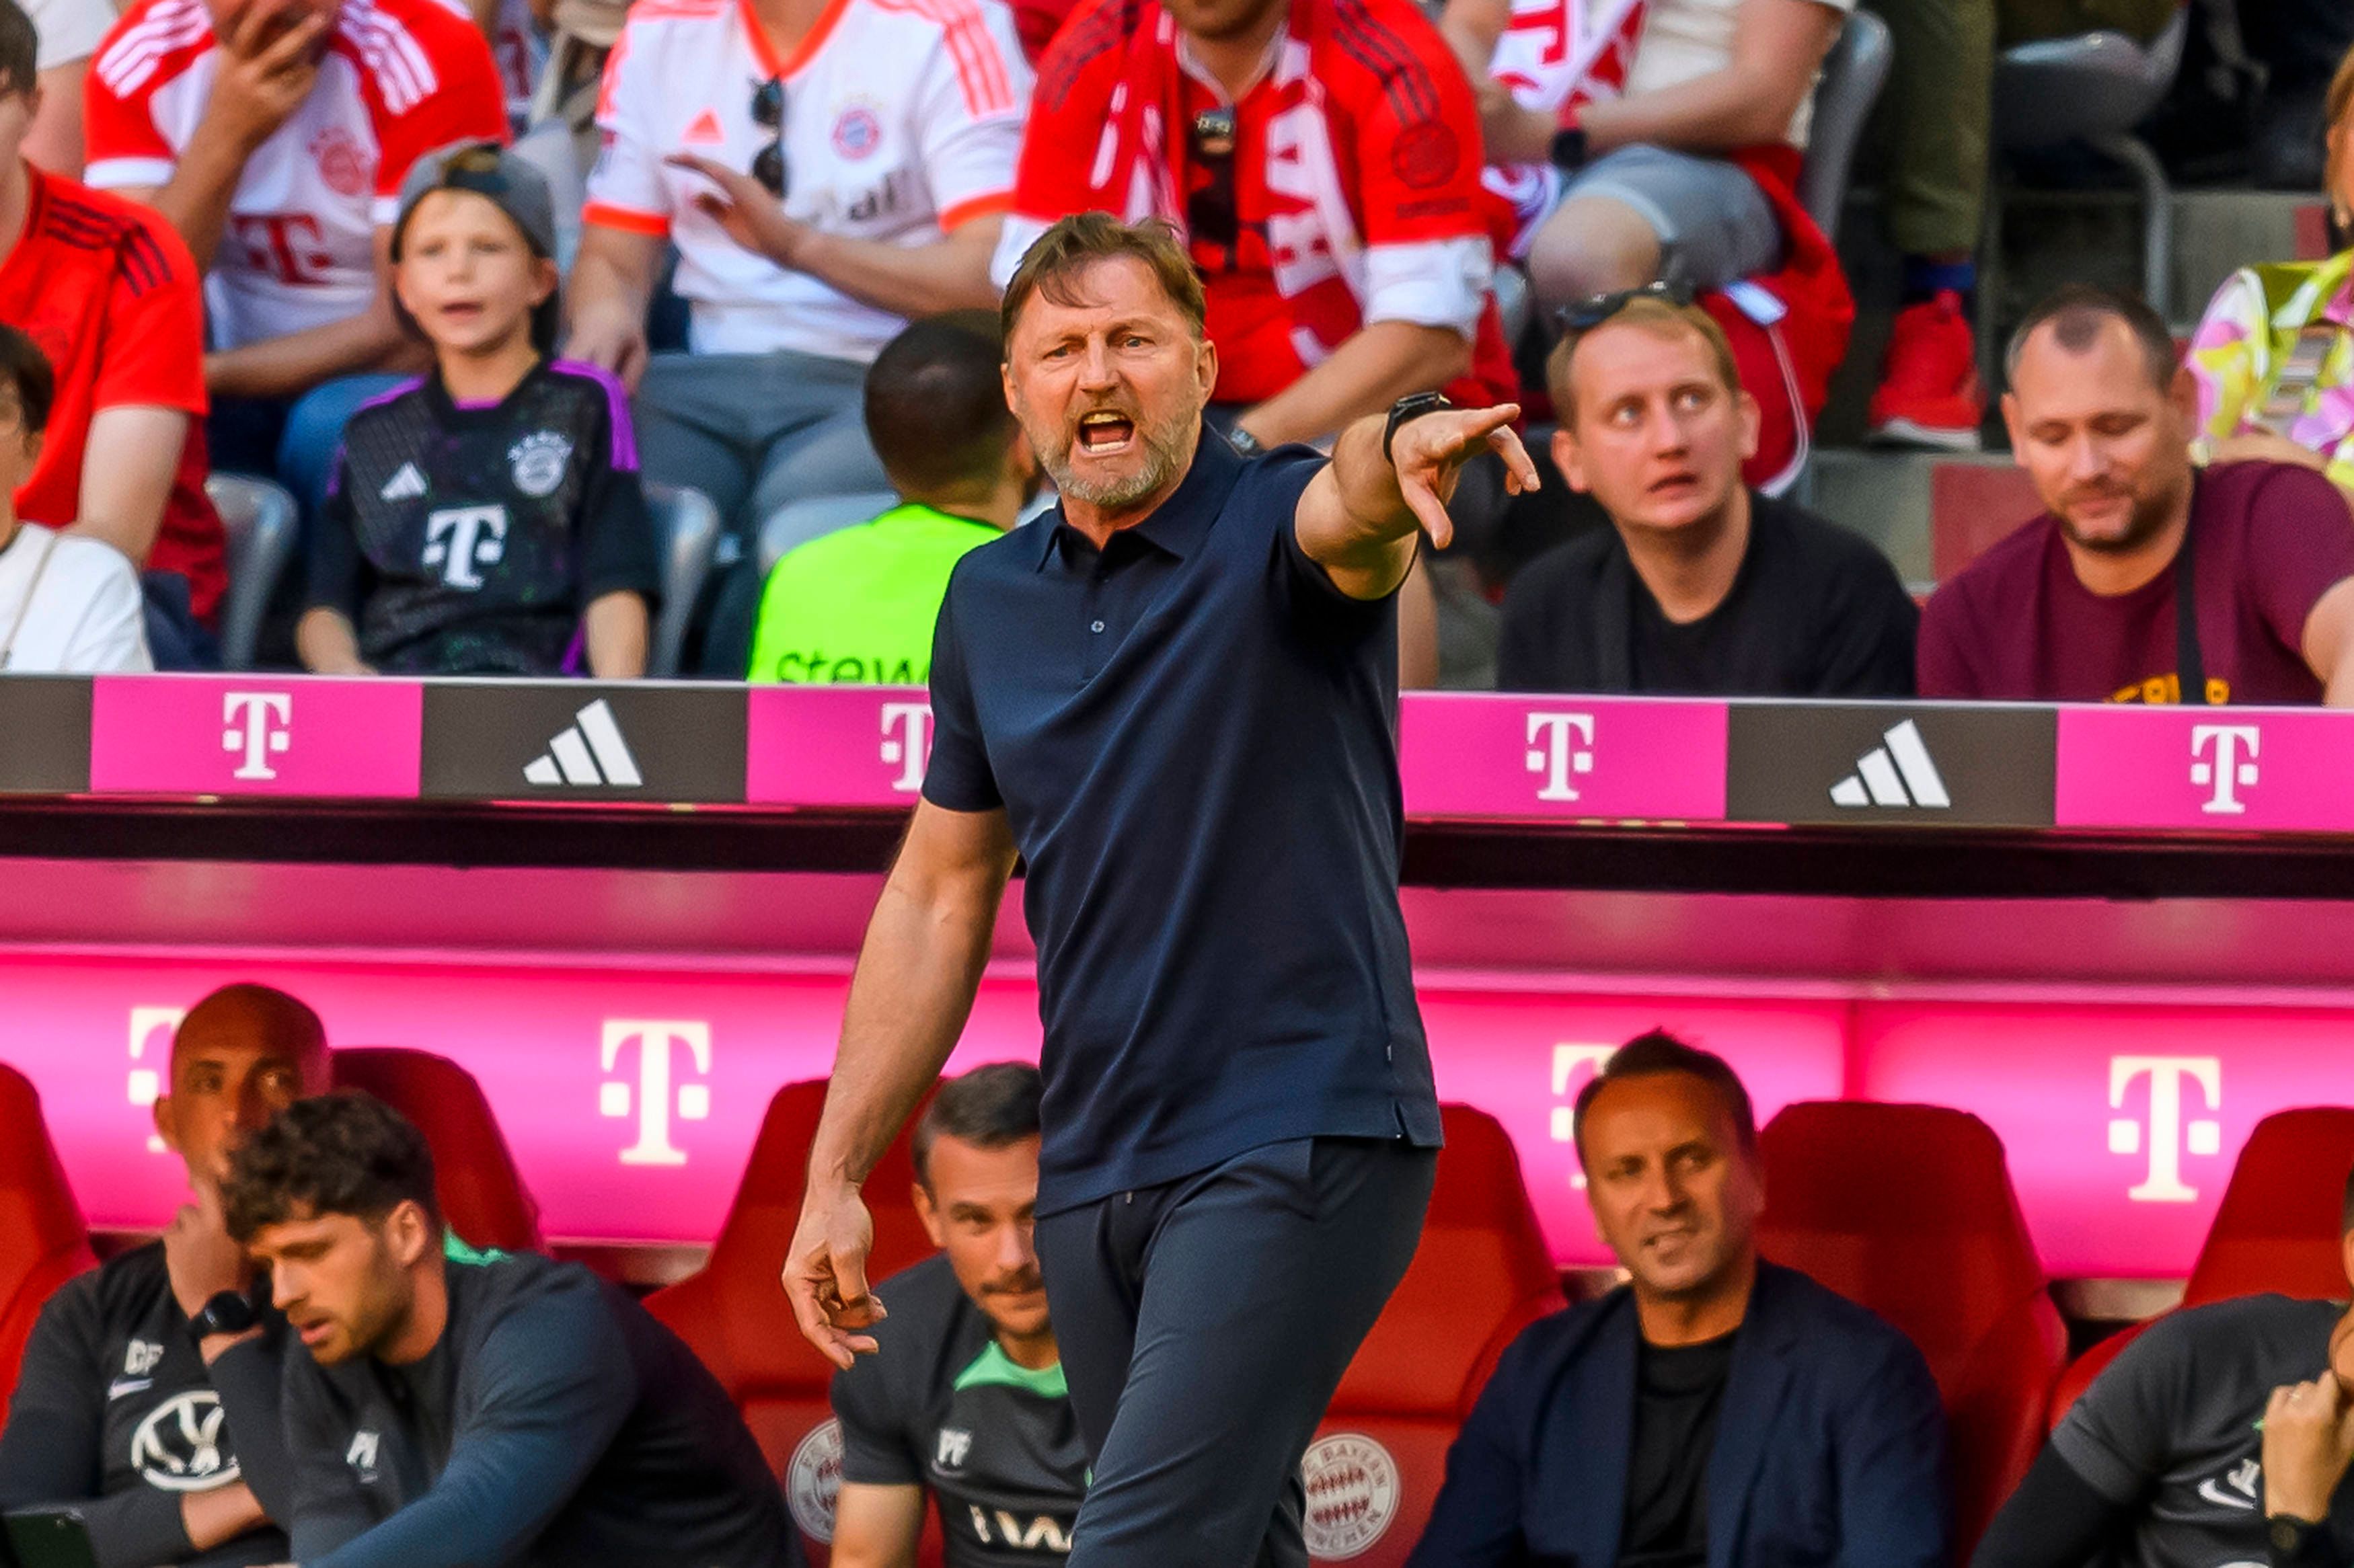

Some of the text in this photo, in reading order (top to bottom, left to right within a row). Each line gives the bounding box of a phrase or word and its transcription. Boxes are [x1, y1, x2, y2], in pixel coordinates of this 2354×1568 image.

[423, 504, 506, 590] T
[223, 693, 291, 779] T
[881, 703, 932, 791] T
[1526, 713, 1593, 800] T
[2191, 725, 2259, 813] T
[599, 1019, 712, 1165] T
[2108, 1056, 2222, 1202] T
